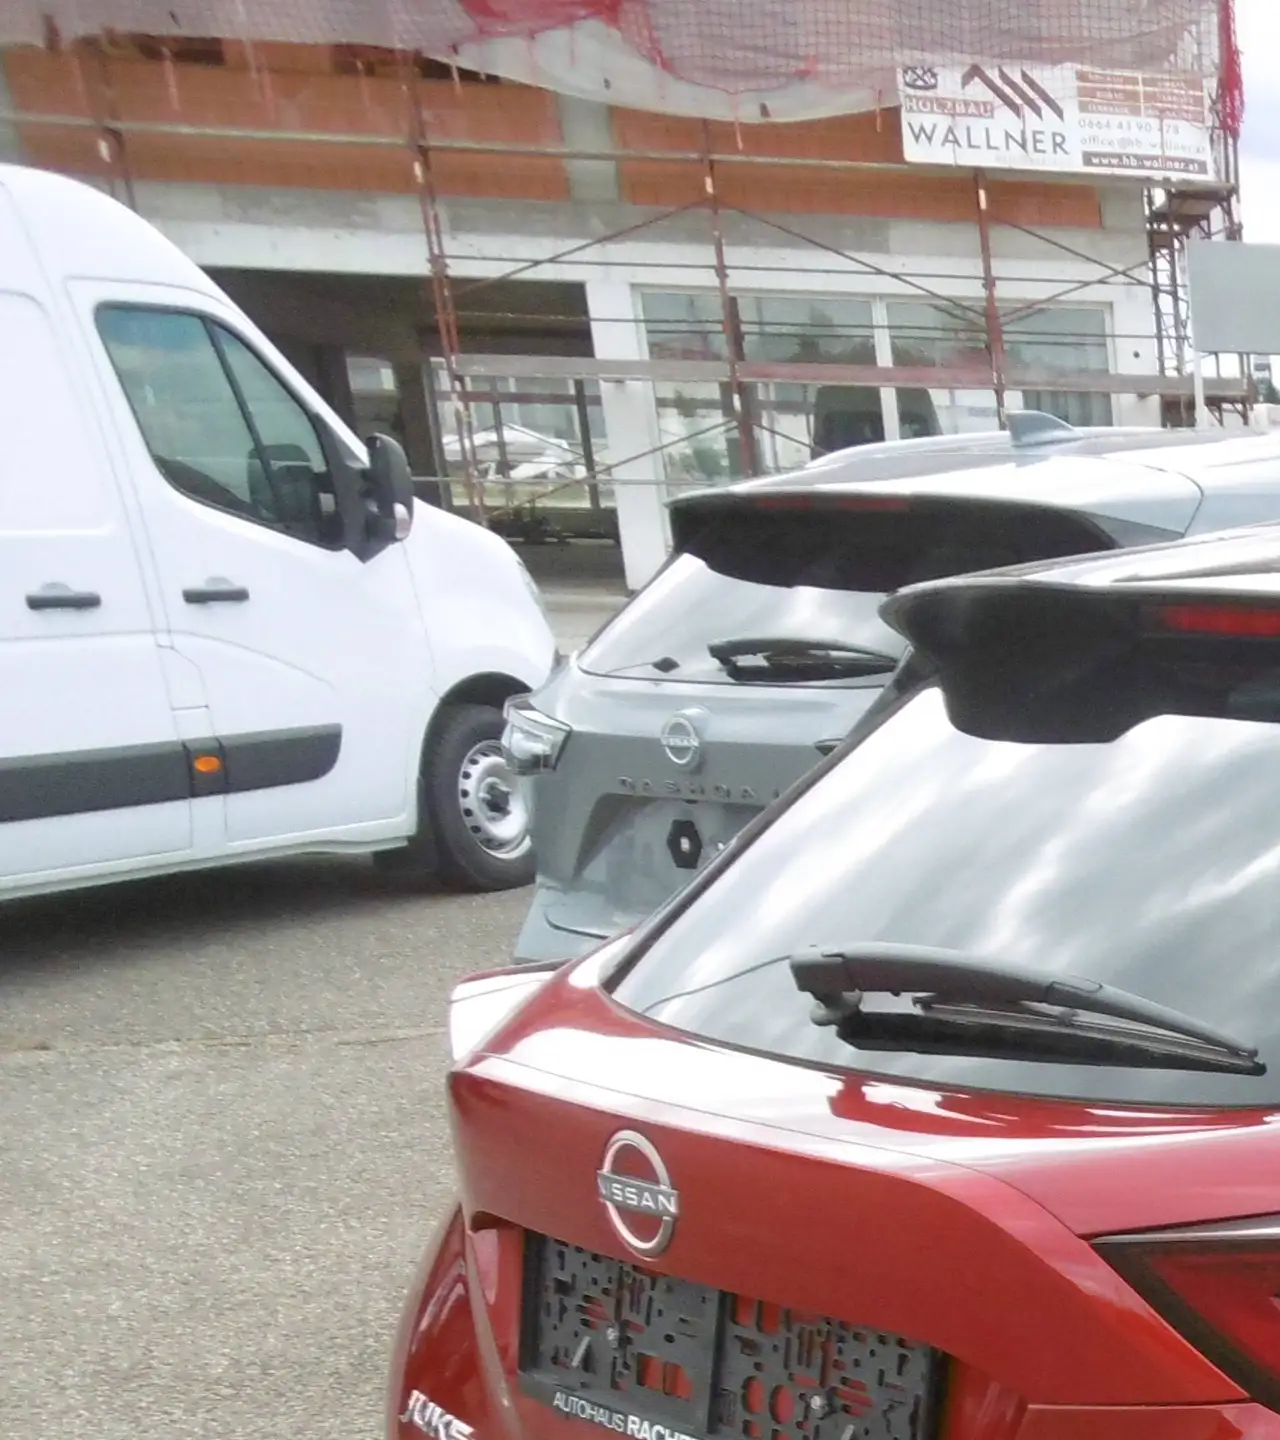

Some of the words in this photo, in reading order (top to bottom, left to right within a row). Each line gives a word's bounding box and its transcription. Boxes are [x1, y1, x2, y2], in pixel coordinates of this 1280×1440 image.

[904, 97, 992, 117] HOLZBAU
[907, 121, 1070, 155] WALLNER
[553, 1391, 625, 1433] AUTOHAUS
